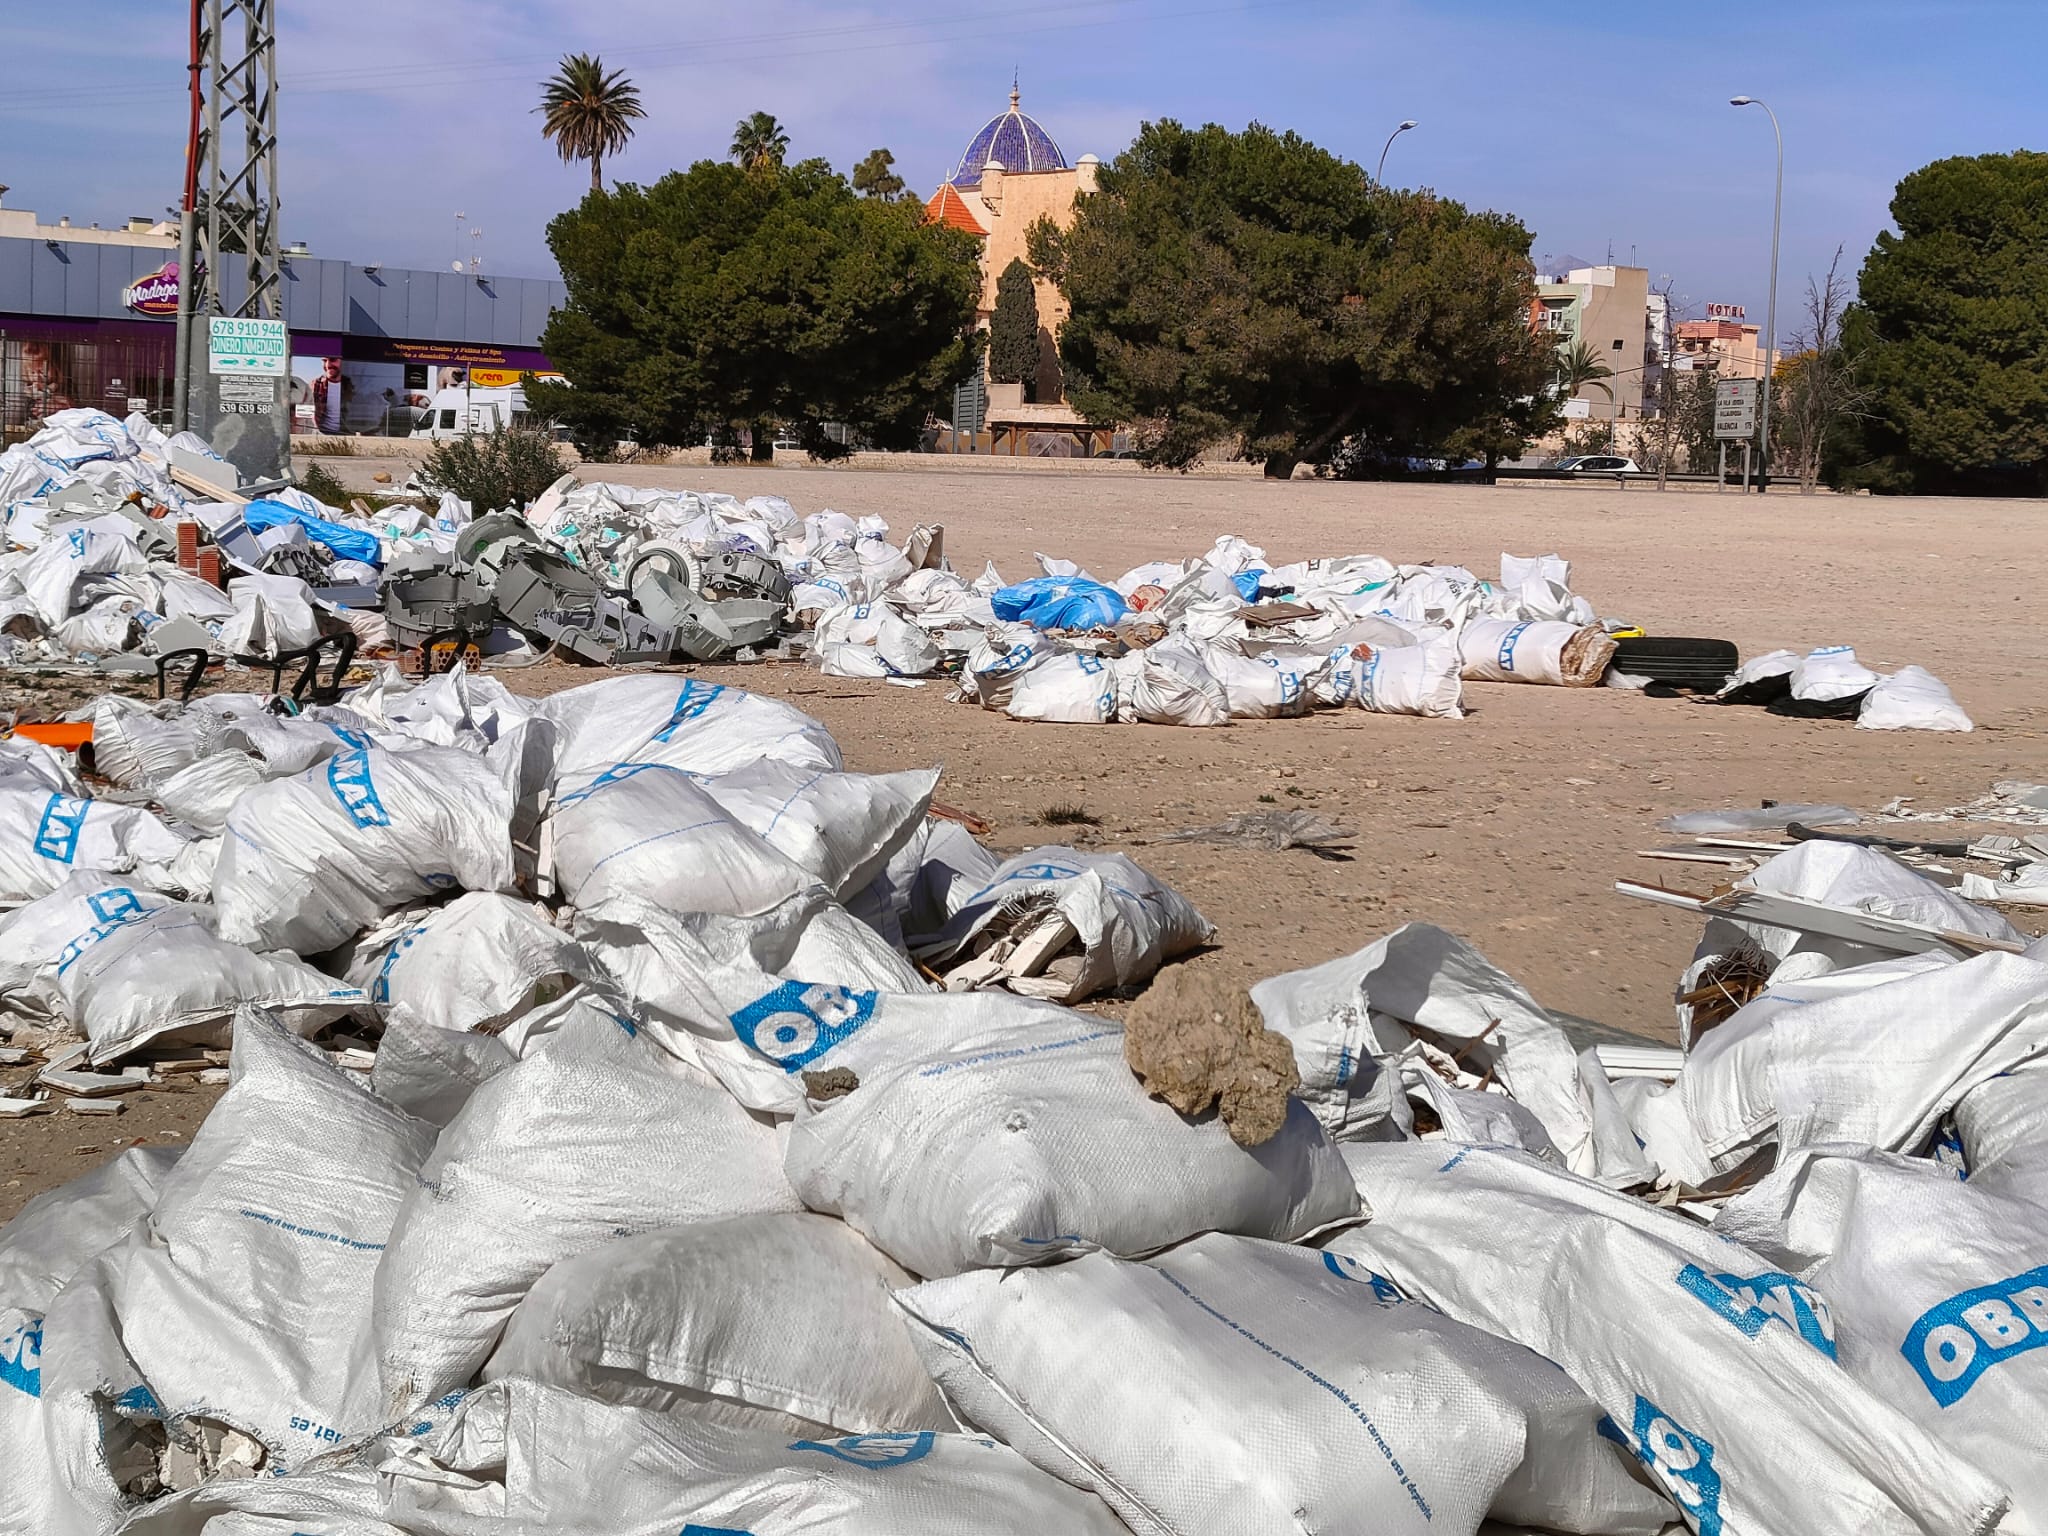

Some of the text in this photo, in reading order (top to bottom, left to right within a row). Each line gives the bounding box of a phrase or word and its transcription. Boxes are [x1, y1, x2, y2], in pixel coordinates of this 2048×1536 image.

[1707, 303, 1744, 318] HOTEL
[212, 320, 283, 337] 678 910 944
[212, 337, 283, 356] DINERO INMEDIATO
[480, 372, 503, 382] sera
[220, 403, 237, 413] 639
[238, 404, 255, 414] 639
[1303, 1368, 1351, 1405] responsable
[1349, 1401, 1361, 1414] de
[1358, 1412, 1370, 1425] su
[1367, 1422, 1393, 1460] correcto
[1391, 1458, 1405, 1477] uso
[1400, 1475, 1411, 1486] y
